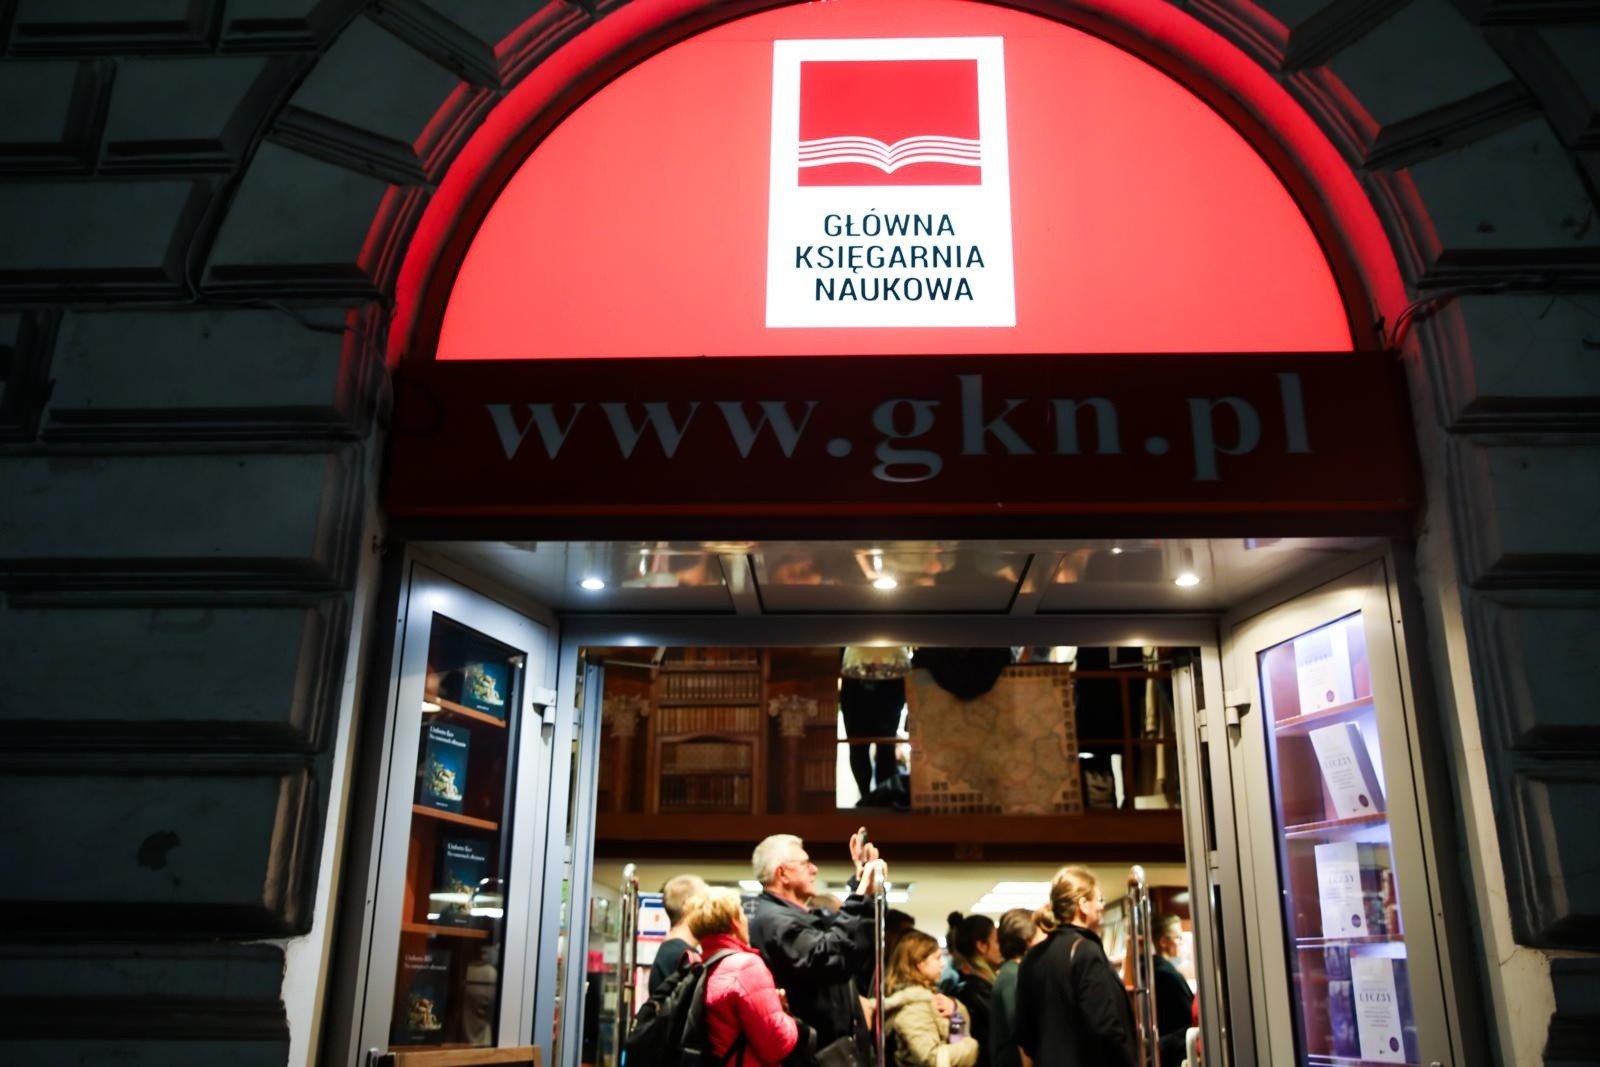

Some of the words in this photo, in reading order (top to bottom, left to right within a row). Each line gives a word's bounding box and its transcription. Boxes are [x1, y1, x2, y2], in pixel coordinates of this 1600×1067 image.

[824, 208, 955, 237] GŁÓWNA
[796, 245, 985, 274] KSIĘGARNIA
[815, 277, 974, 301] NAUKOWA
[486, 373, 1313, 483] www.gkn.pl
